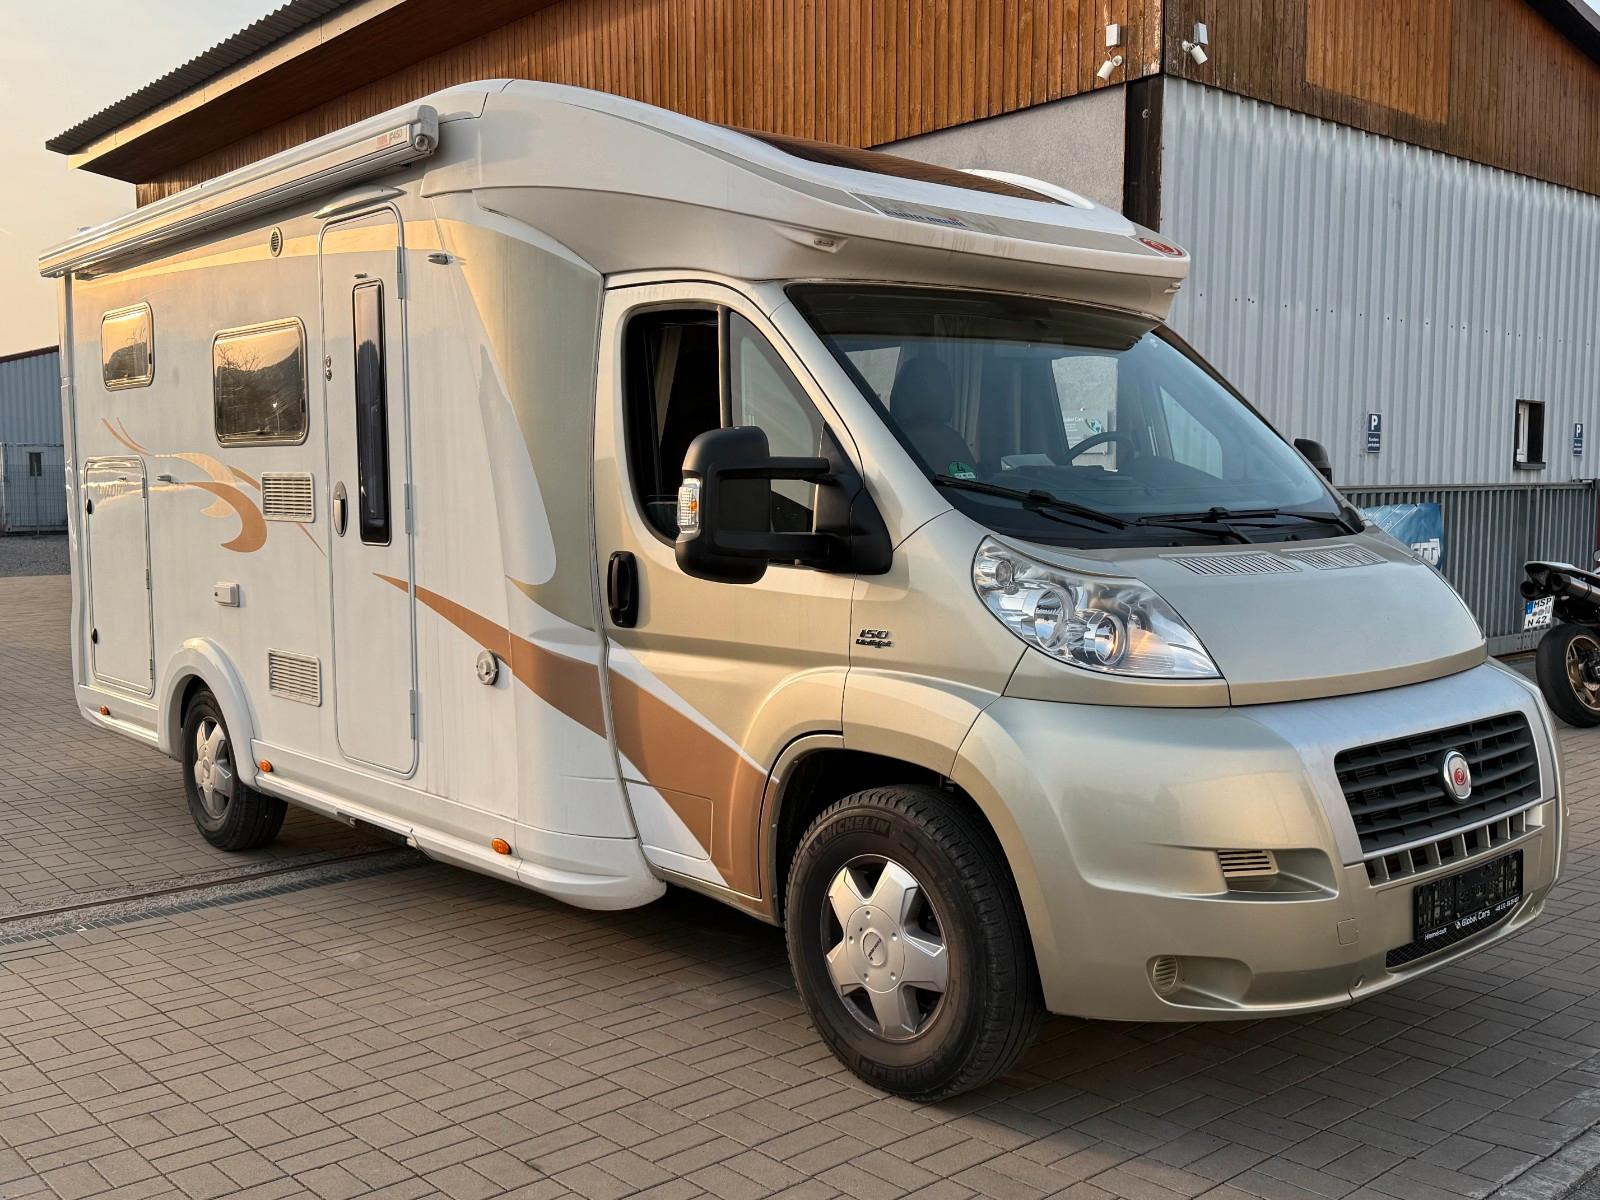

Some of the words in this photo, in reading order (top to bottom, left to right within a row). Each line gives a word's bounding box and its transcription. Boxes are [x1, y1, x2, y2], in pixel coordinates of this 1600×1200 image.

[1371, 414, 1379, 431] P
[1576, 424, 1582, 438] P
[1533, 597, 1552, 609] MSP
[1527, 619, 1534, 627] N
[1535, 615, 1547, 625] 42
[859, 629, 889, 639] 150
[1477, 909, 1491, 921] Cars
